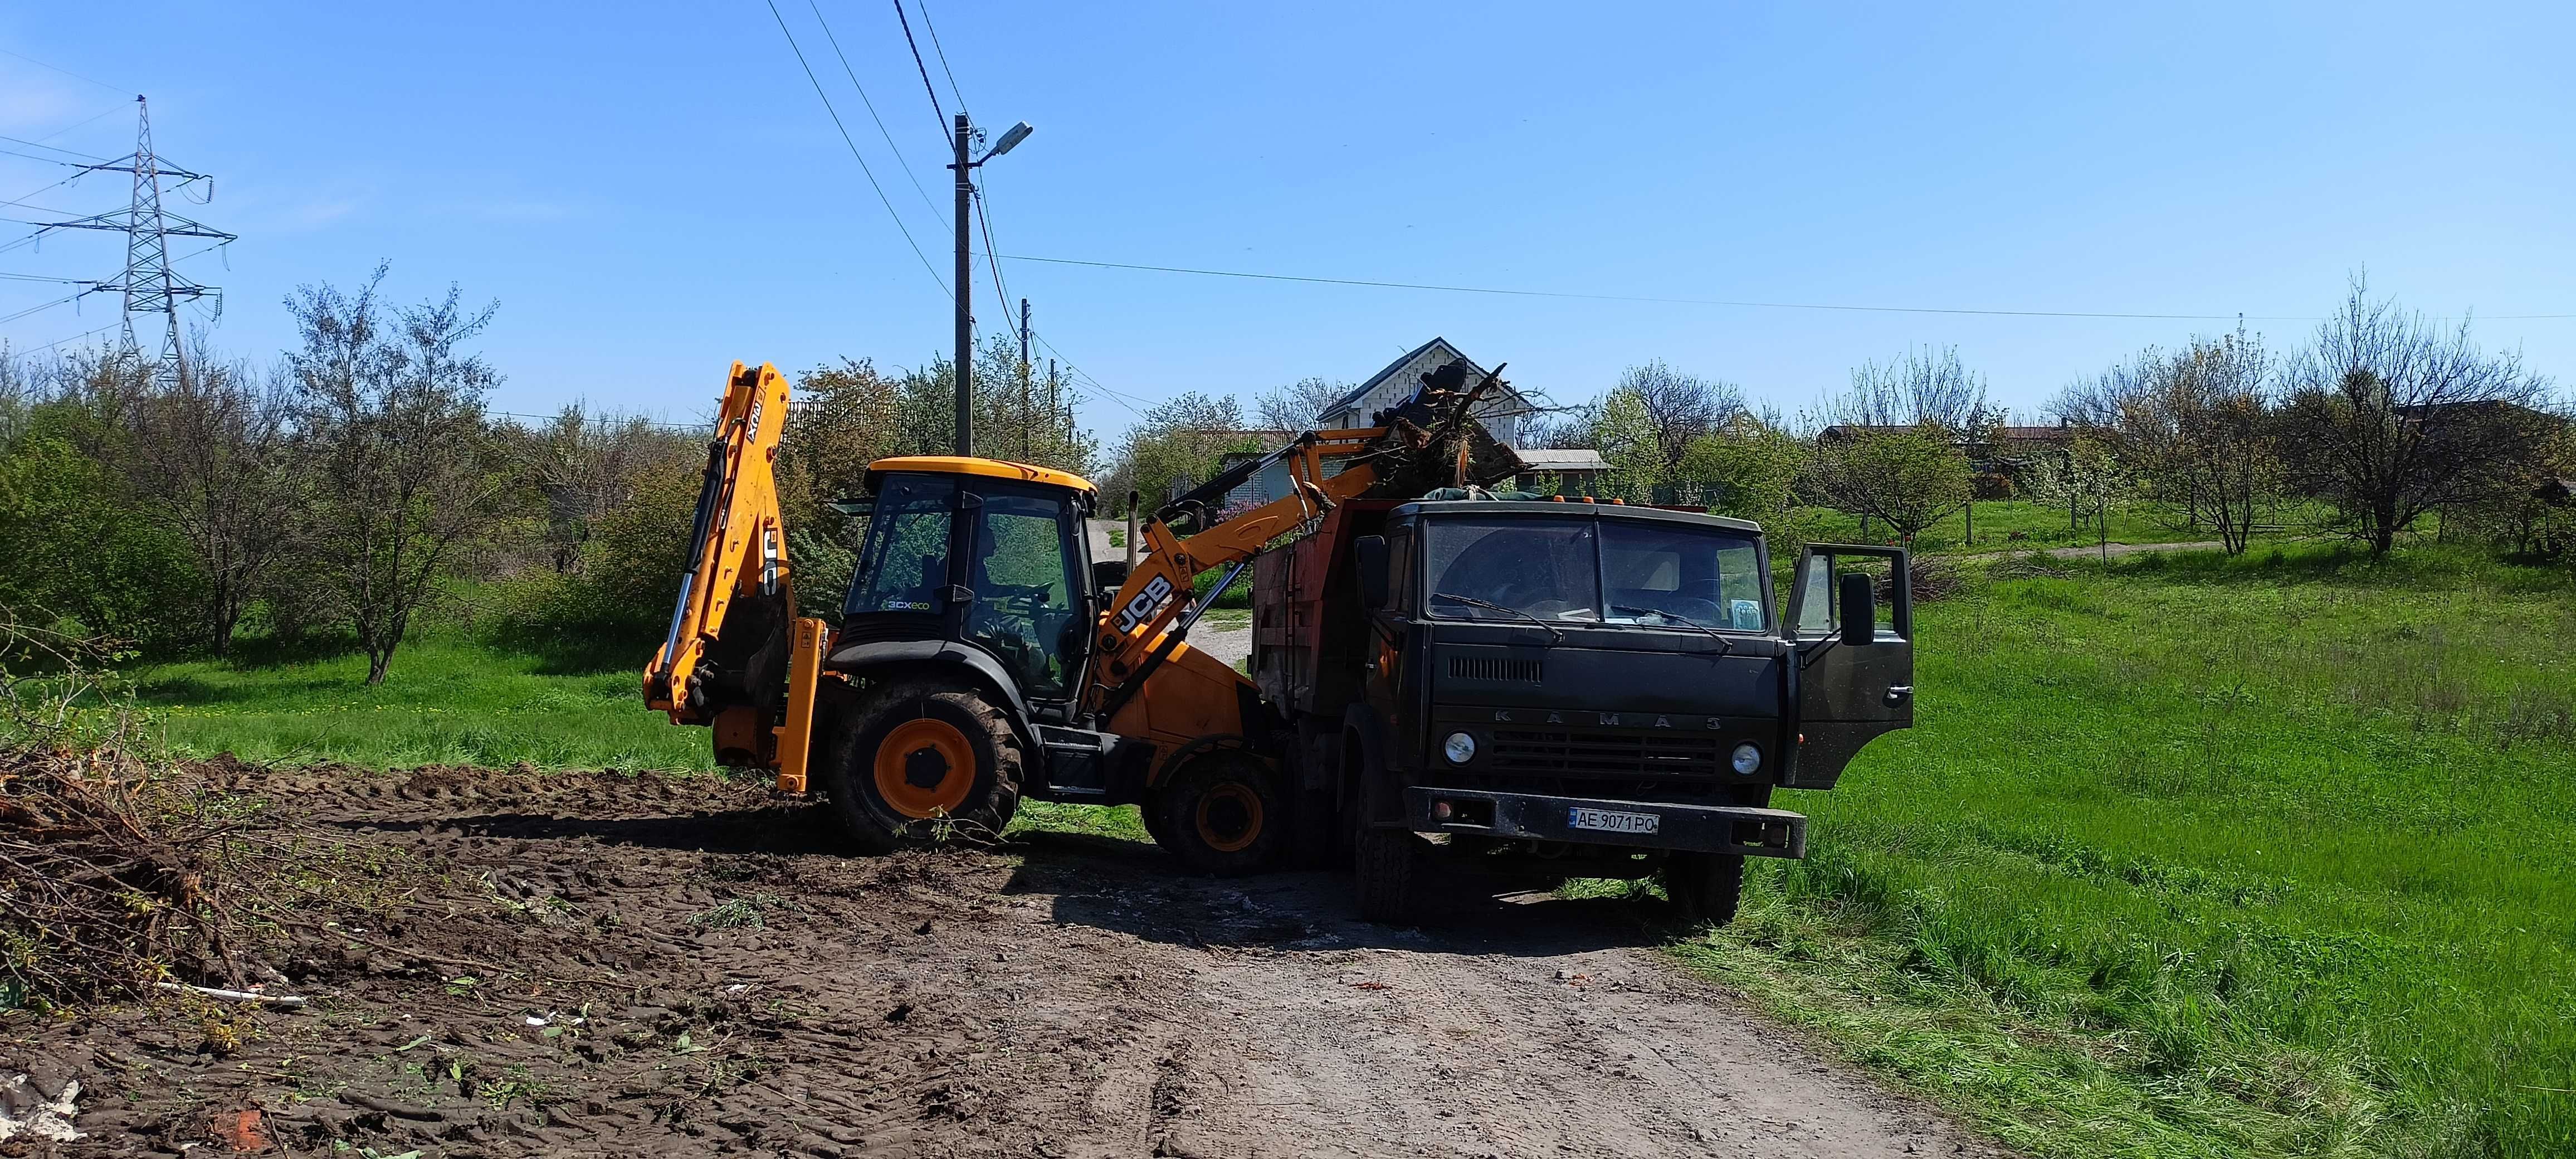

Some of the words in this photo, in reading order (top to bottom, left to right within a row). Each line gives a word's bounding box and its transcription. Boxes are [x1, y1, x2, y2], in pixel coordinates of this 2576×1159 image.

[748, 402, 761, 440] 3CX
[764, 531, 777, 596] JC
[1119, 576, 1170, 632] JCB
[1577, 812, 1597, 827] AE
[1601, 814, 1632, 830] 9071
[1635, 816, 1655, 831] PO
